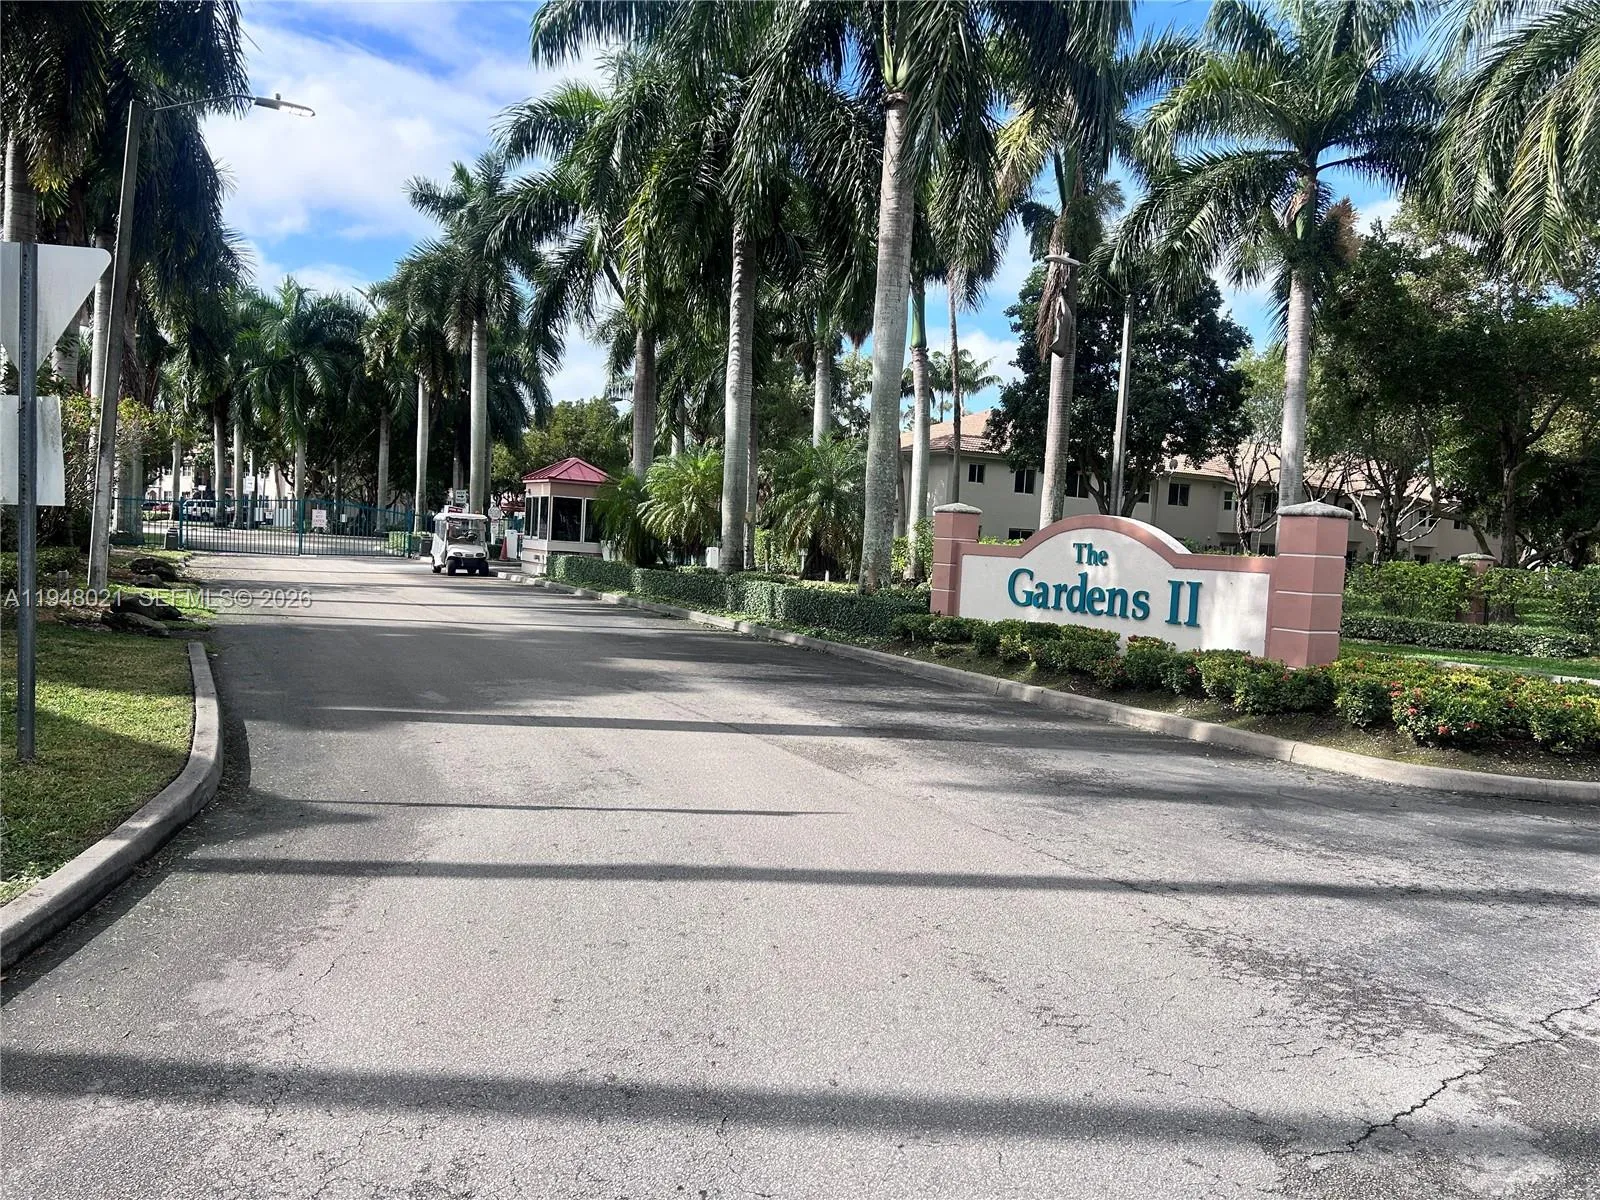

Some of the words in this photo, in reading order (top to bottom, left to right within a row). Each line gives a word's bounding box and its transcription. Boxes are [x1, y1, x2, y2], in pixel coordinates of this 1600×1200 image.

[1073, 543, 1109, 566] The
[1008, 568, 1150, 620] Gardens
[1165, 580, 1202, 627] II
